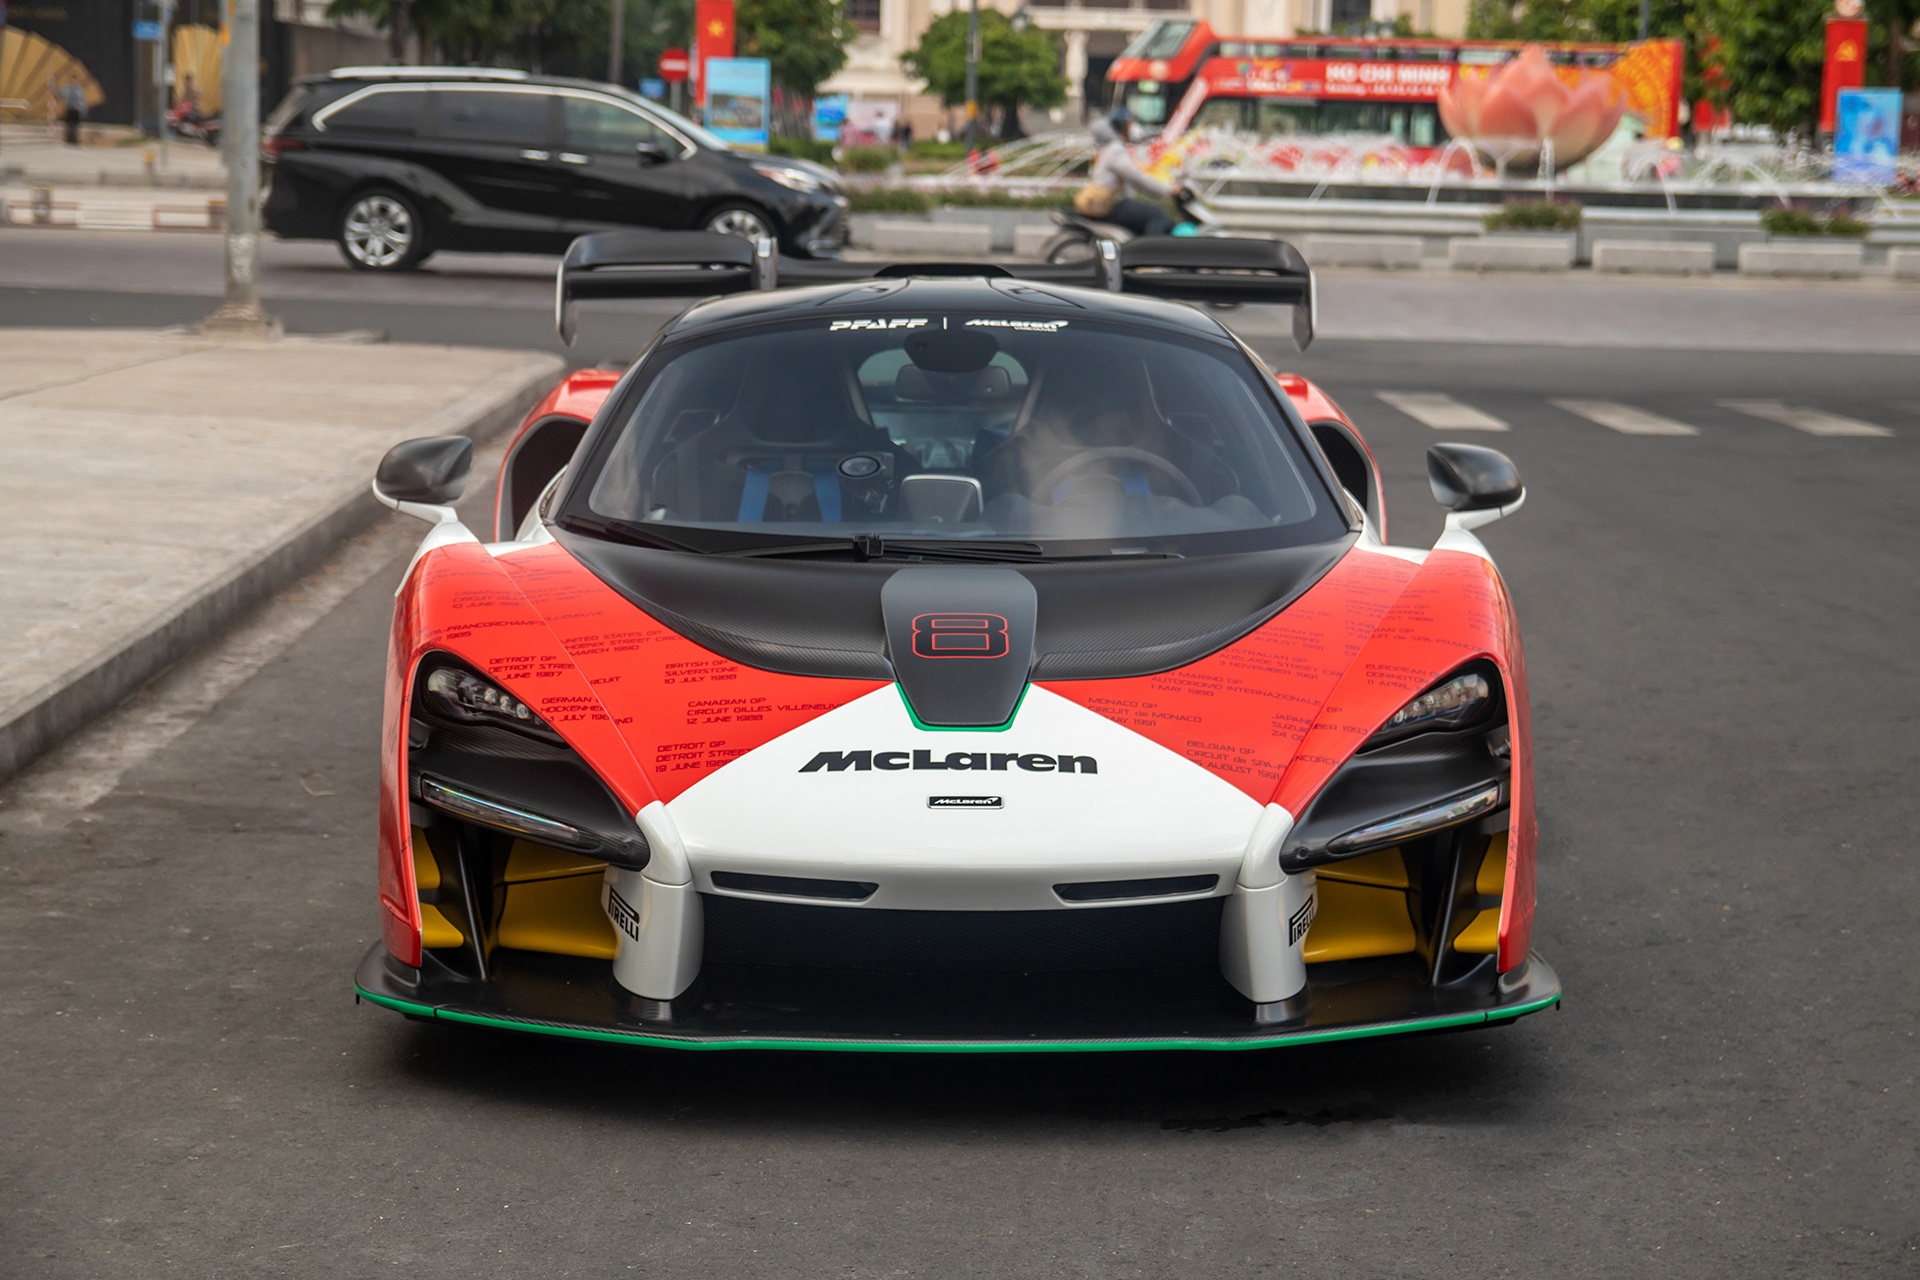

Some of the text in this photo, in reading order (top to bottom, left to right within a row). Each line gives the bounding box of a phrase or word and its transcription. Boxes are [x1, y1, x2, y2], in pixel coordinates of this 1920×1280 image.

[1327, 63, 1449, 83] HO CHI MINH
[829, 318, 929, 331] PFAFF
[964, 319, 1060, 329] McLaren
[446, 631, 472, 640] 1985
[602, 631, 643, 640] STATES
[912, 613, 1010, 658] 8
[609, 637, 652, 645] STREET
[489, 656, 537, 664] DETROIT
[665, 661, 709, 669] BRITISH
[1219, 654, 1273, 664] ADELAIDE
[1276, 661, 1320, 672] STREET
[488, 664, 536, 674] DETROIT
[664, 666, 739, 677] SILVERSTONE
[1229, 662, 1292, 675] NOVEMBER
[1296, 672, 1318, 680] 1991
[1365, 664, 1426, 675] EUROPEAN
[502, 672, 532, 680] JUNE
[679, 676, 706, 684] JULY
[1178, 672, 1224, 682] MARINO
[1378, 680, 1412, 690] APRIL
[1151, 676, 1322, 706] AUTODROMO INTERNAZIONALE
[1158, 685, 1183, 693] MAY
[1187, 688, 1215, 697] 1988
[687, 698, 747, 708] CANADIAN
[1088, 697, 1138, 707] MONACO
[686, 707, 730, 716] CIRCUIT
[559, 714, 586, 722] JULY
[702, 716, 732, 724] JUNE
[1133, 718, 1157, 726] 1991
[1151, 712, 1202, 723] MONACO
[1271, 730, 1287, 738] 24
[657, 742, 707, 752] DETROIT
[1186, 740, 1256, 755] BELGIAN GP
[655, 752, 705, 762] DETROIT
[1186, 749, 1230, 761] CIRCUIT
[798, 750, 1098, 774] McLaren
[655, 765, 667, 773] 19
[670, 762, 702, 771] JUNE
[1207, 761, 1253, 775] AUGUST
[1257, 770, 1281, 780] 1991
[608, 886, 640, 942] PIRELLI
